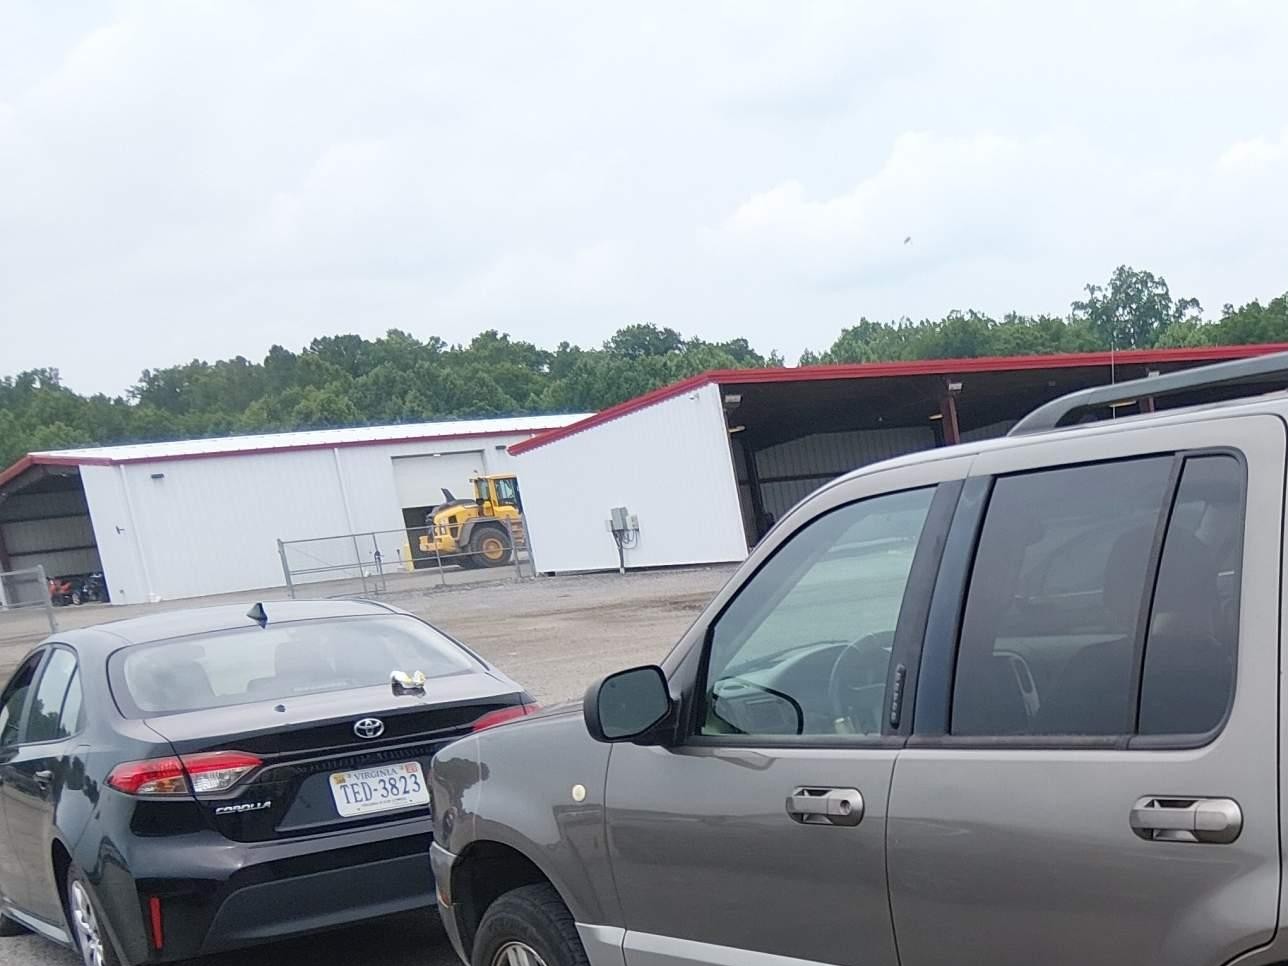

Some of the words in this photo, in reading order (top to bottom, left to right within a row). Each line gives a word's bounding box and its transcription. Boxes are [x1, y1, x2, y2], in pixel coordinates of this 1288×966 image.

[353, 768, 399, 781] VIRGINIA
[340, 773, 421, 804] TED-3823
[215, 800, 272, 815] COROLLA
